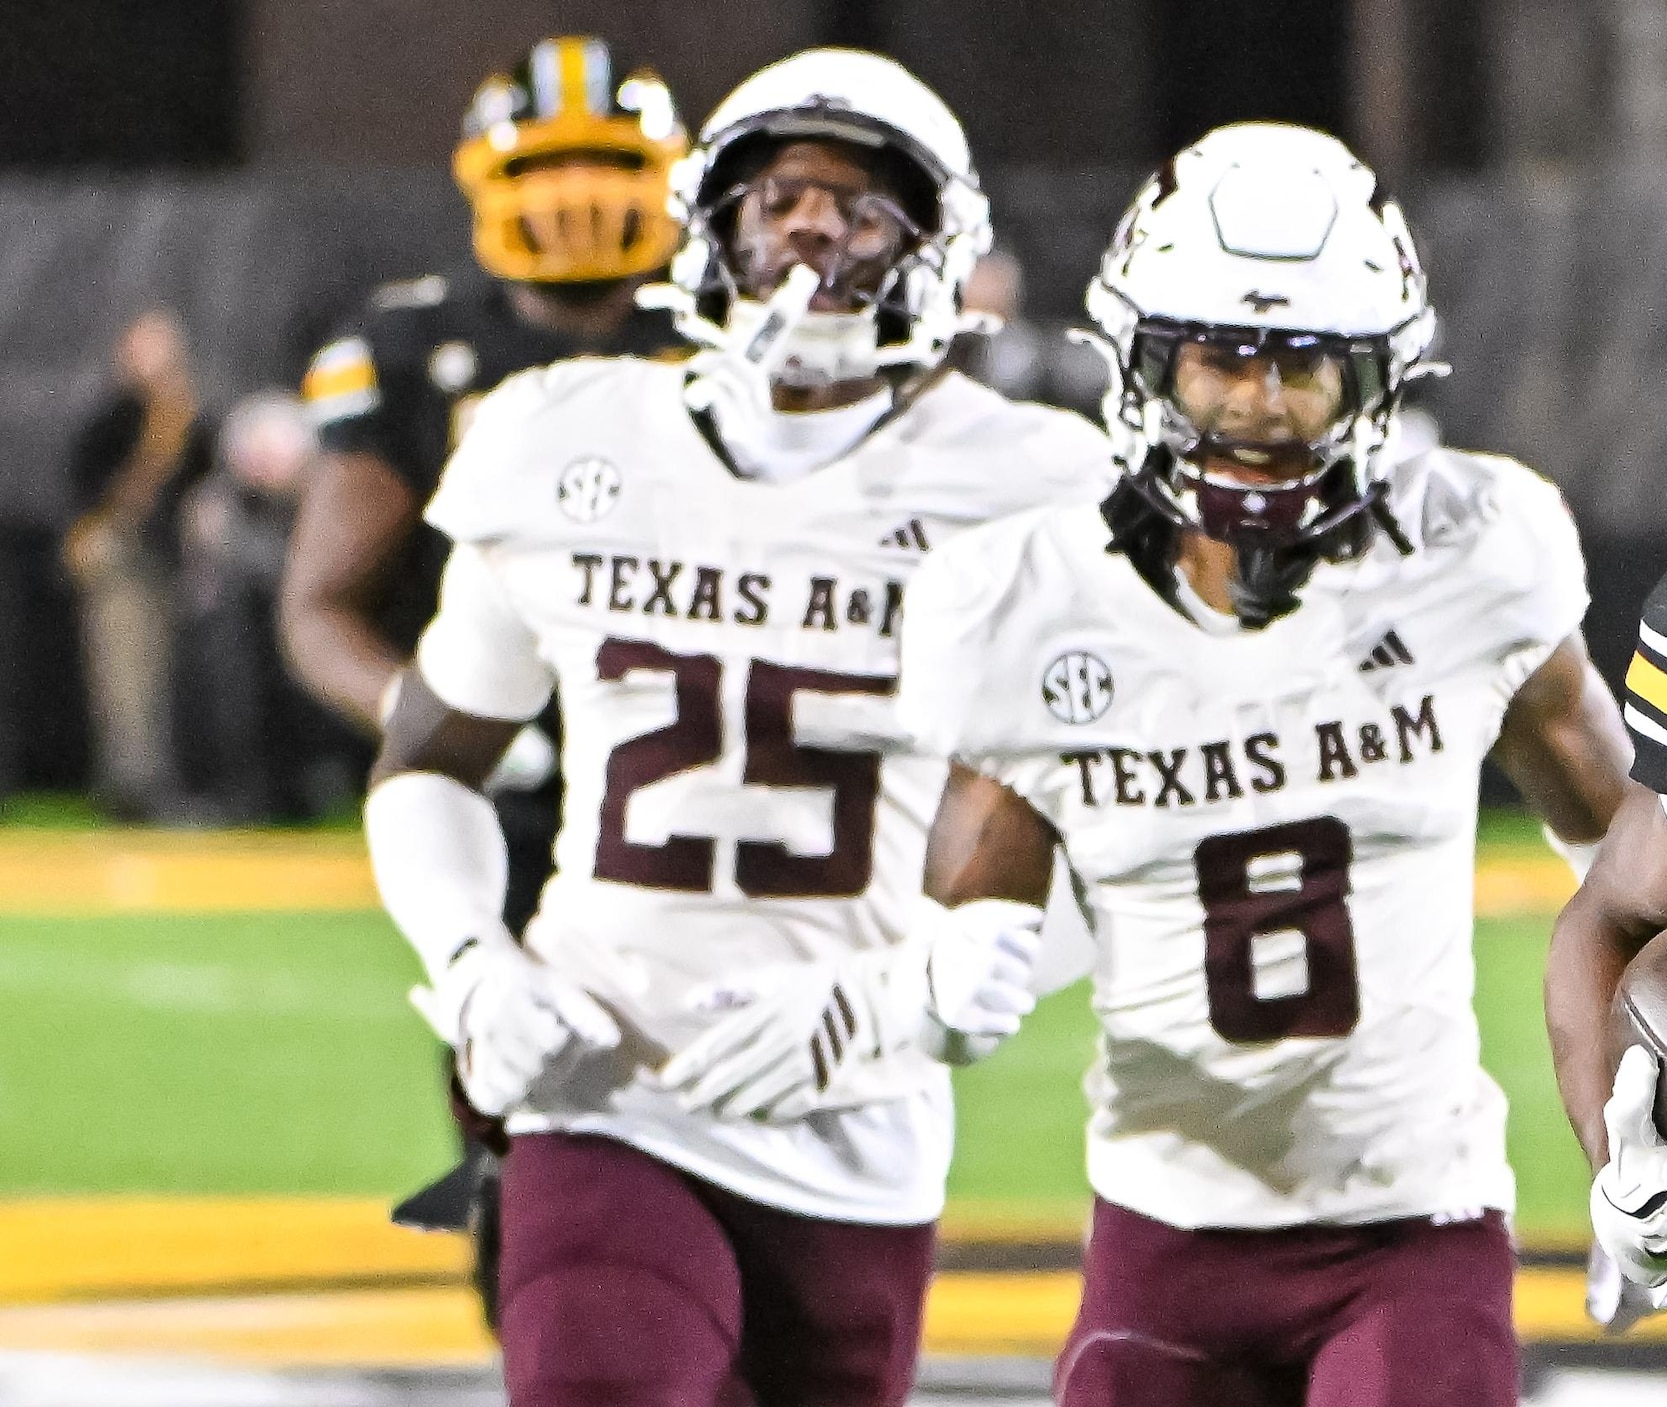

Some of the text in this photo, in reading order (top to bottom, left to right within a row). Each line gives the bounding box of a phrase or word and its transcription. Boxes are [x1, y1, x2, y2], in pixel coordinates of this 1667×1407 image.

[573, 553, 771, 627] TEXAS
[594, 636, 898, 897] 25
[1062, 695, 1444, 807] TEXAS A&M
[1193, 814, 1361, 1045] 8
